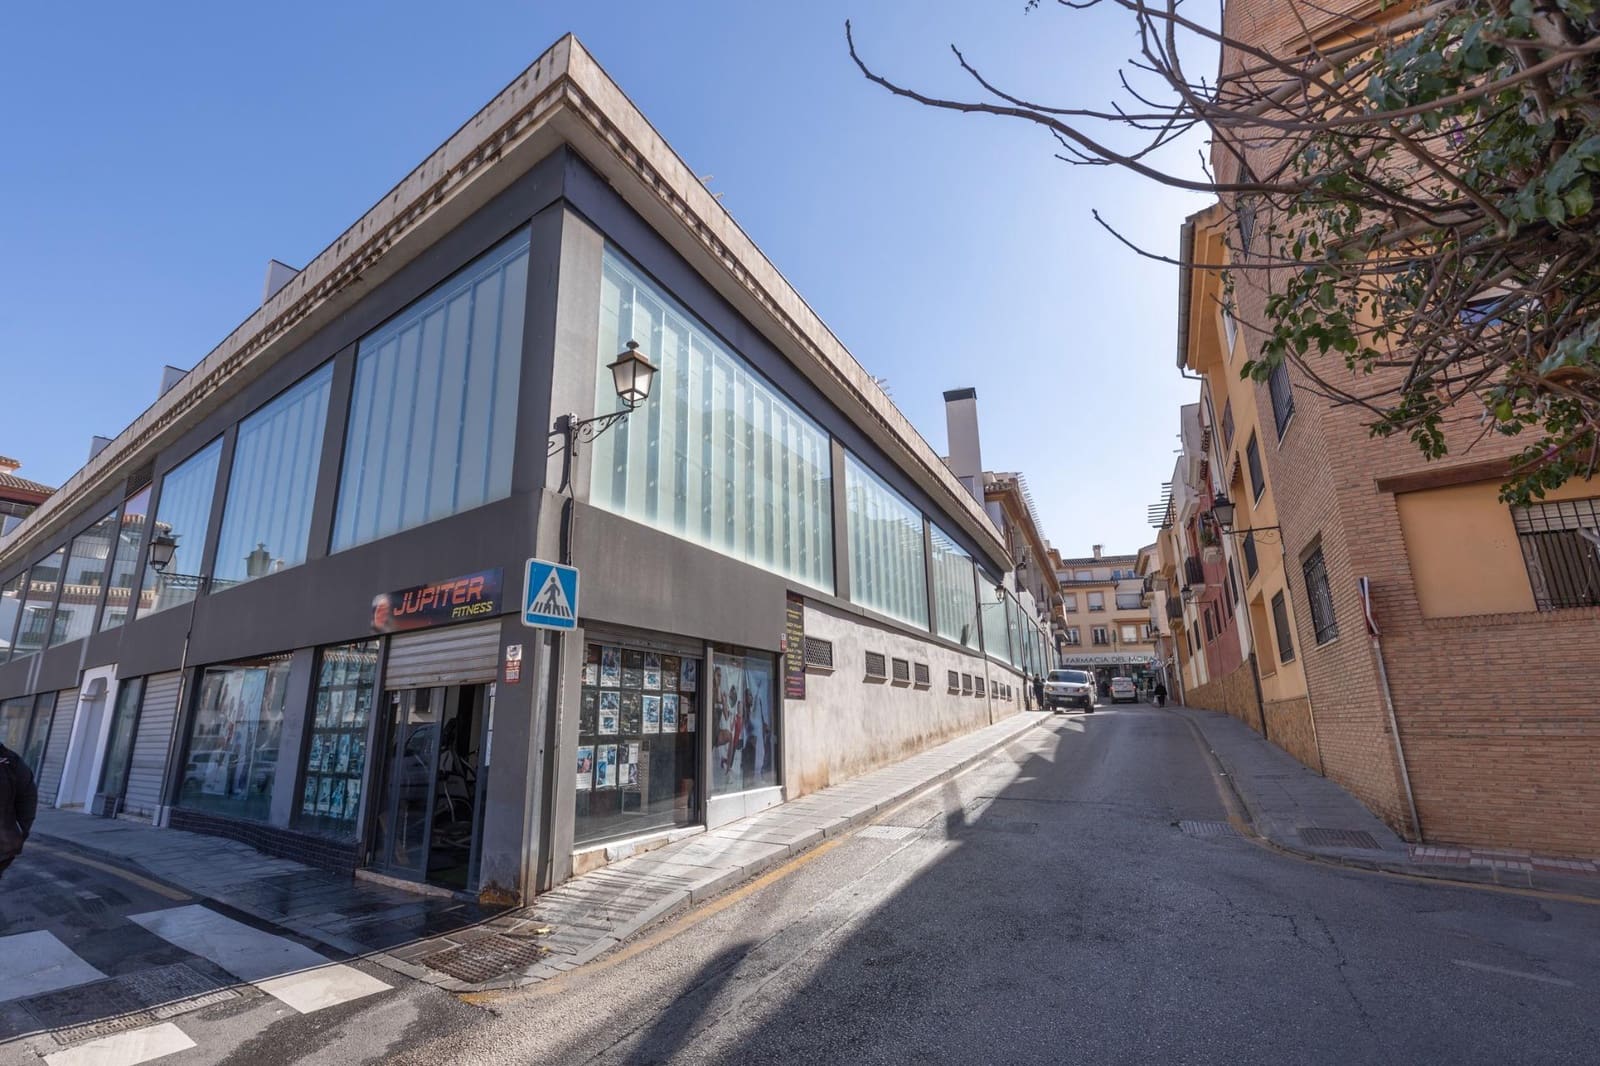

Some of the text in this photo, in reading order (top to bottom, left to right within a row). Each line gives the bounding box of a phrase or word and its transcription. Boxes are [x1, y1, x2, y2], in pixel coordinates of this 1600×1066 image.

[393, 575, 485, 617] JUPITER
[451, 600, 494, 619] FITNESS
[1065, 655, 1155, 664] FARMACIA DEL MORA
